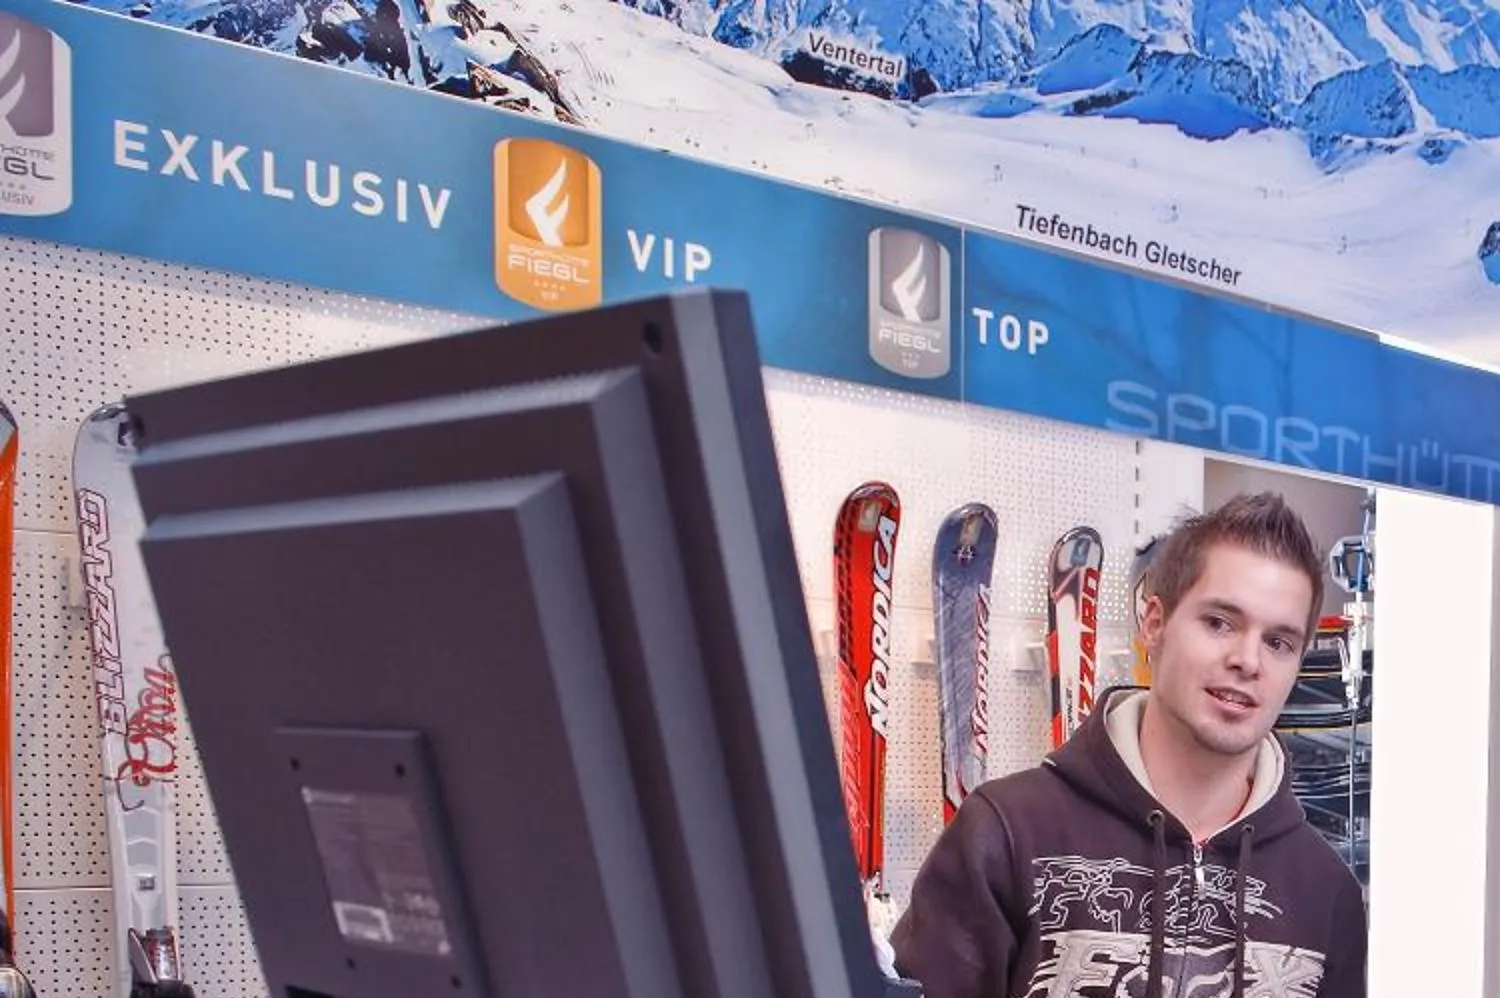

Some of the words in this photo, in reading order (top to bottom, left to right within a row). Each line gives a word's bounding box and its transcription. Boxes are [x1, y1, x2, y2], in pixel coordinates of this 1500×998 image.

[809, 31, 903, 77] Ventertal
[113, 119, 452, 229] EXKLUSIV
[508, 254, 590, 284] FIEGL
[627, 229, 712, 282] VIP
[1016, 204, 1138, 258] Tiefenbach
[1145, 241, 1242, 286] Gletscher
[879, 328, 942, 353] FIEGL
[972, 307, 1049, 355] TOP
[79, 488, 128, 738] BLIZZARD
[864, 515, 897, 739] NORDICA
